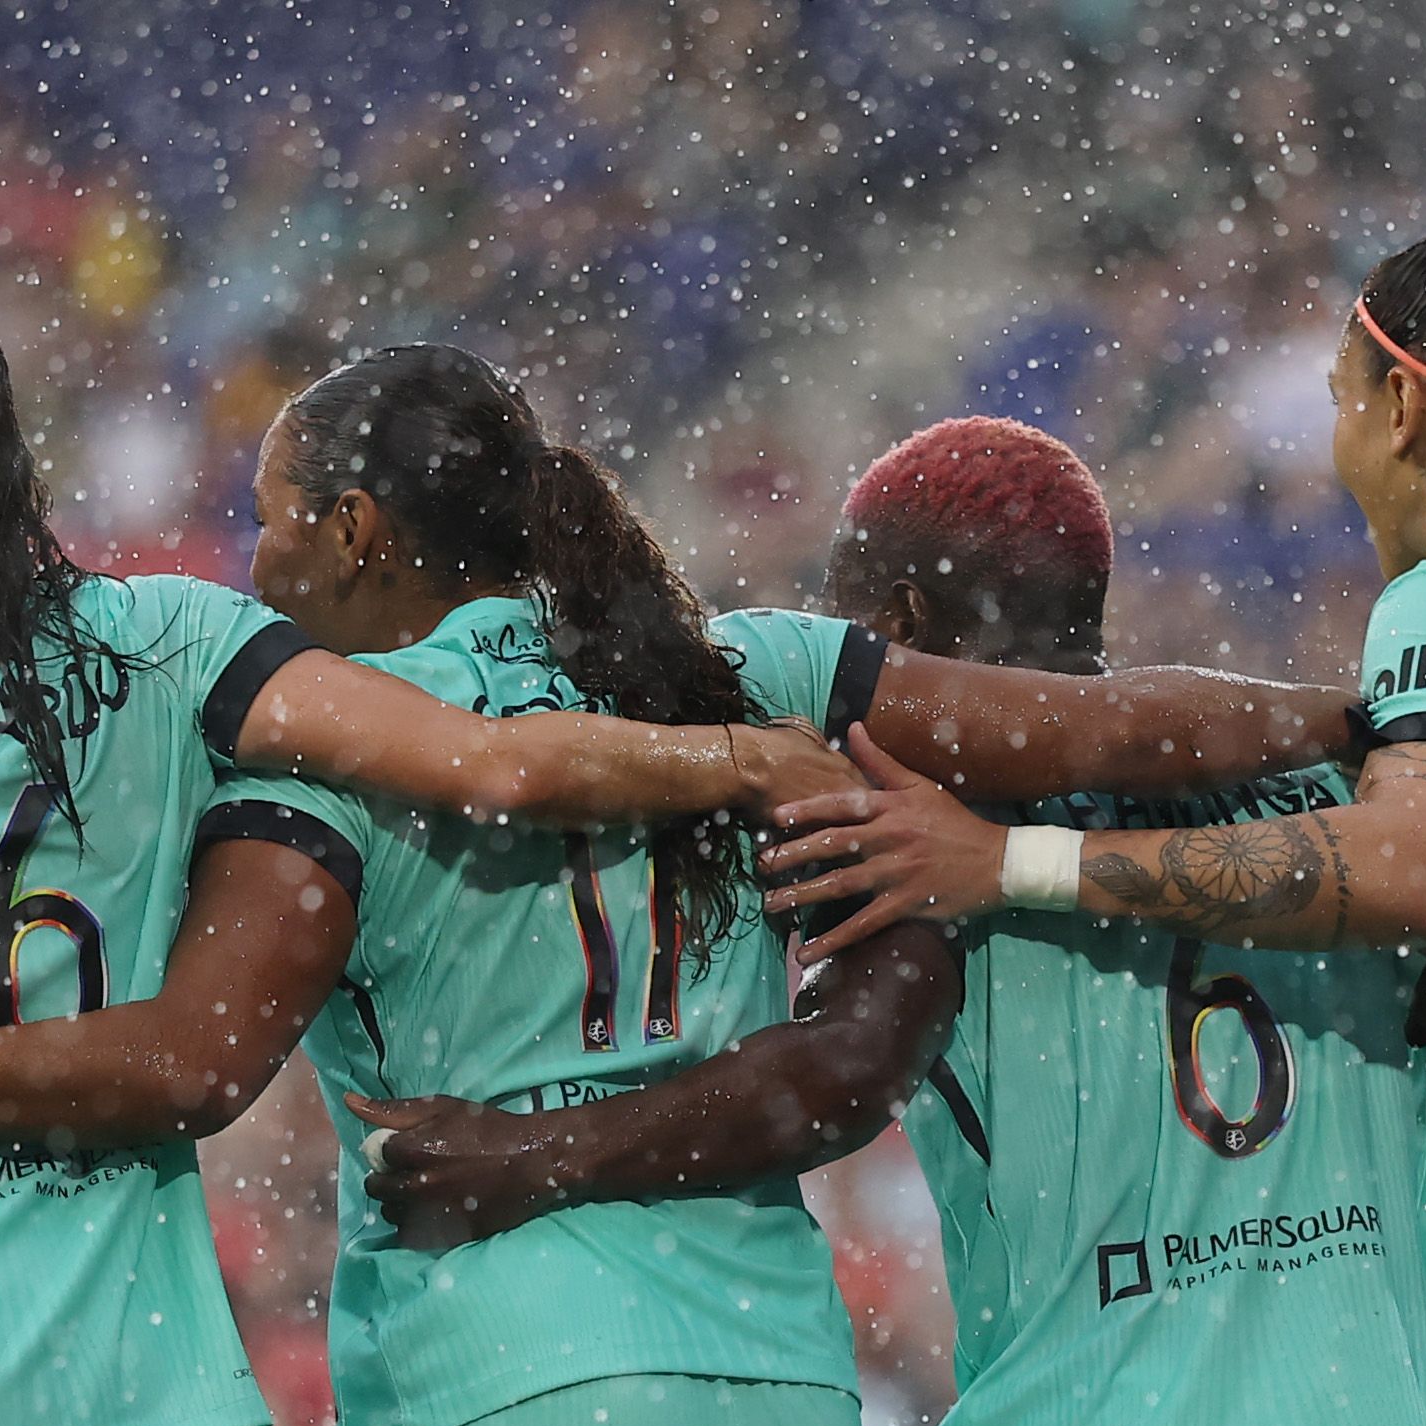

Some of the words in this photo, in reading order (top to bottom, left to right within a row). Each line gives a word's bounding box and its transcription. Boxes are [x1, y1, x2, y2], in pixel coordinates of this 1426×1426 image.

[1166, 938, 1296, 1160] 6
[35, 1160, 159, 1199] MANAGEMEN
[1162, 1204, 1384, 1268] PALMERSQUAR
[1166, 1257, 1247, 1291] APITAL
[1256, 1241, 1388, 1273] MANAGEME
